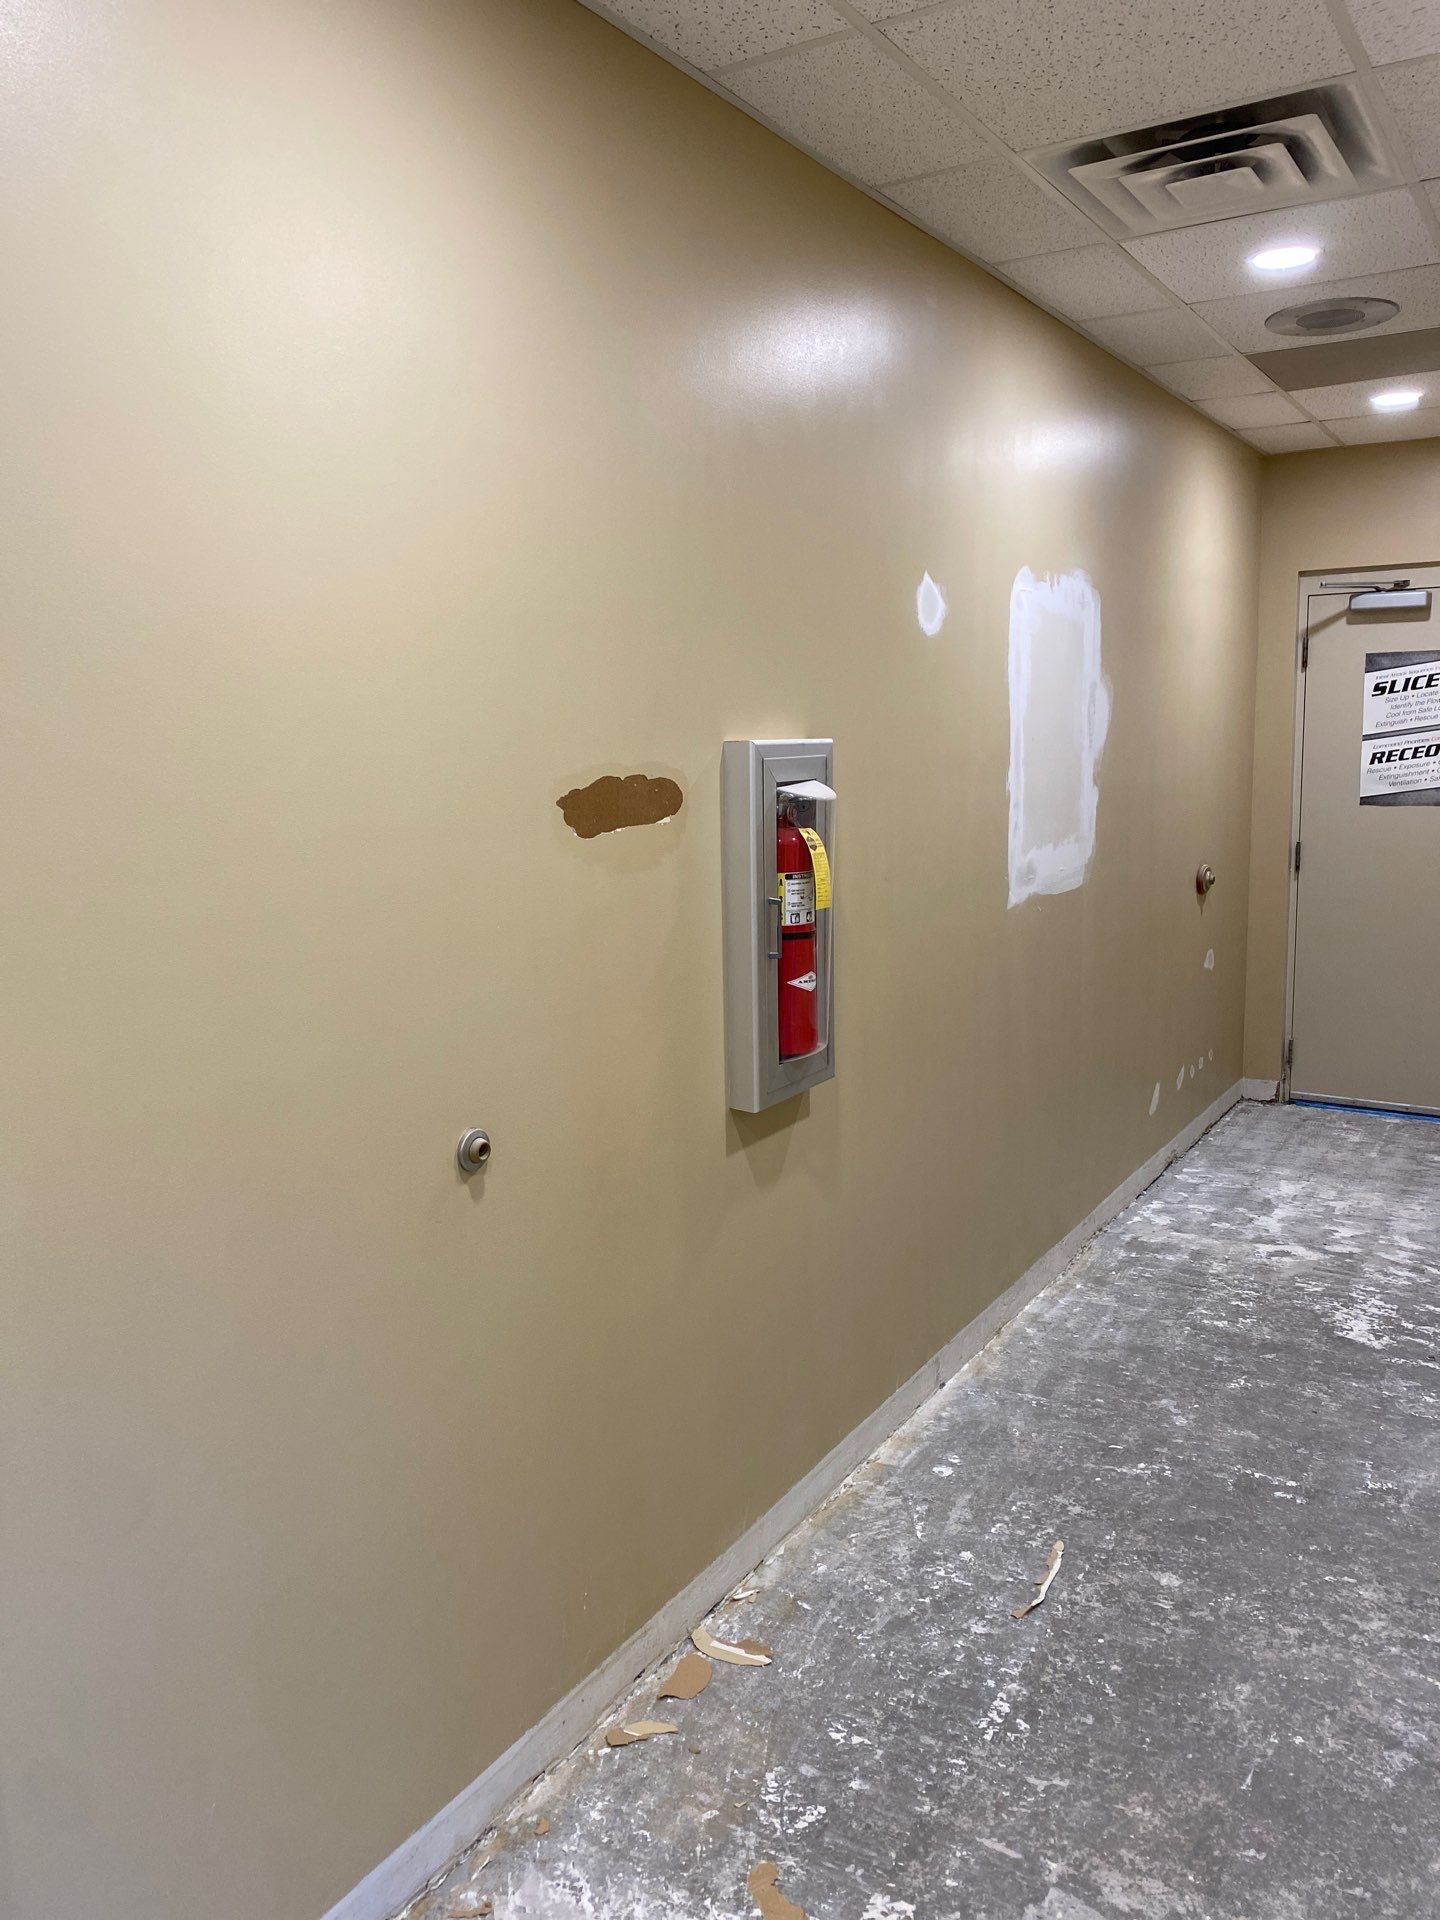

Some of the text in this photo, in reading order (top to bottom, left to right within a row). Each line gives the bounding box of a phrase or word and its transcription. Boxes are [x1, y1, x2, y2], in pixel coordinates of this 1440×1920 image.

[1417, 690, 1439, 698] Locate
[1386, 711, 1401, 719] Cool
[1418, 706, 1433, 714] Safe
[1390, 701, 1414, 711] Identify
[1375, 714, 1439, 728] Extinguish Rescue
[1367, 767, 1392, 775] Rescue
[1399, 761, 1430, 771] Exposure
[1379, 768, 1430, 781] Extinguishment
[1389, 778, 1422, 787] Ventilation
